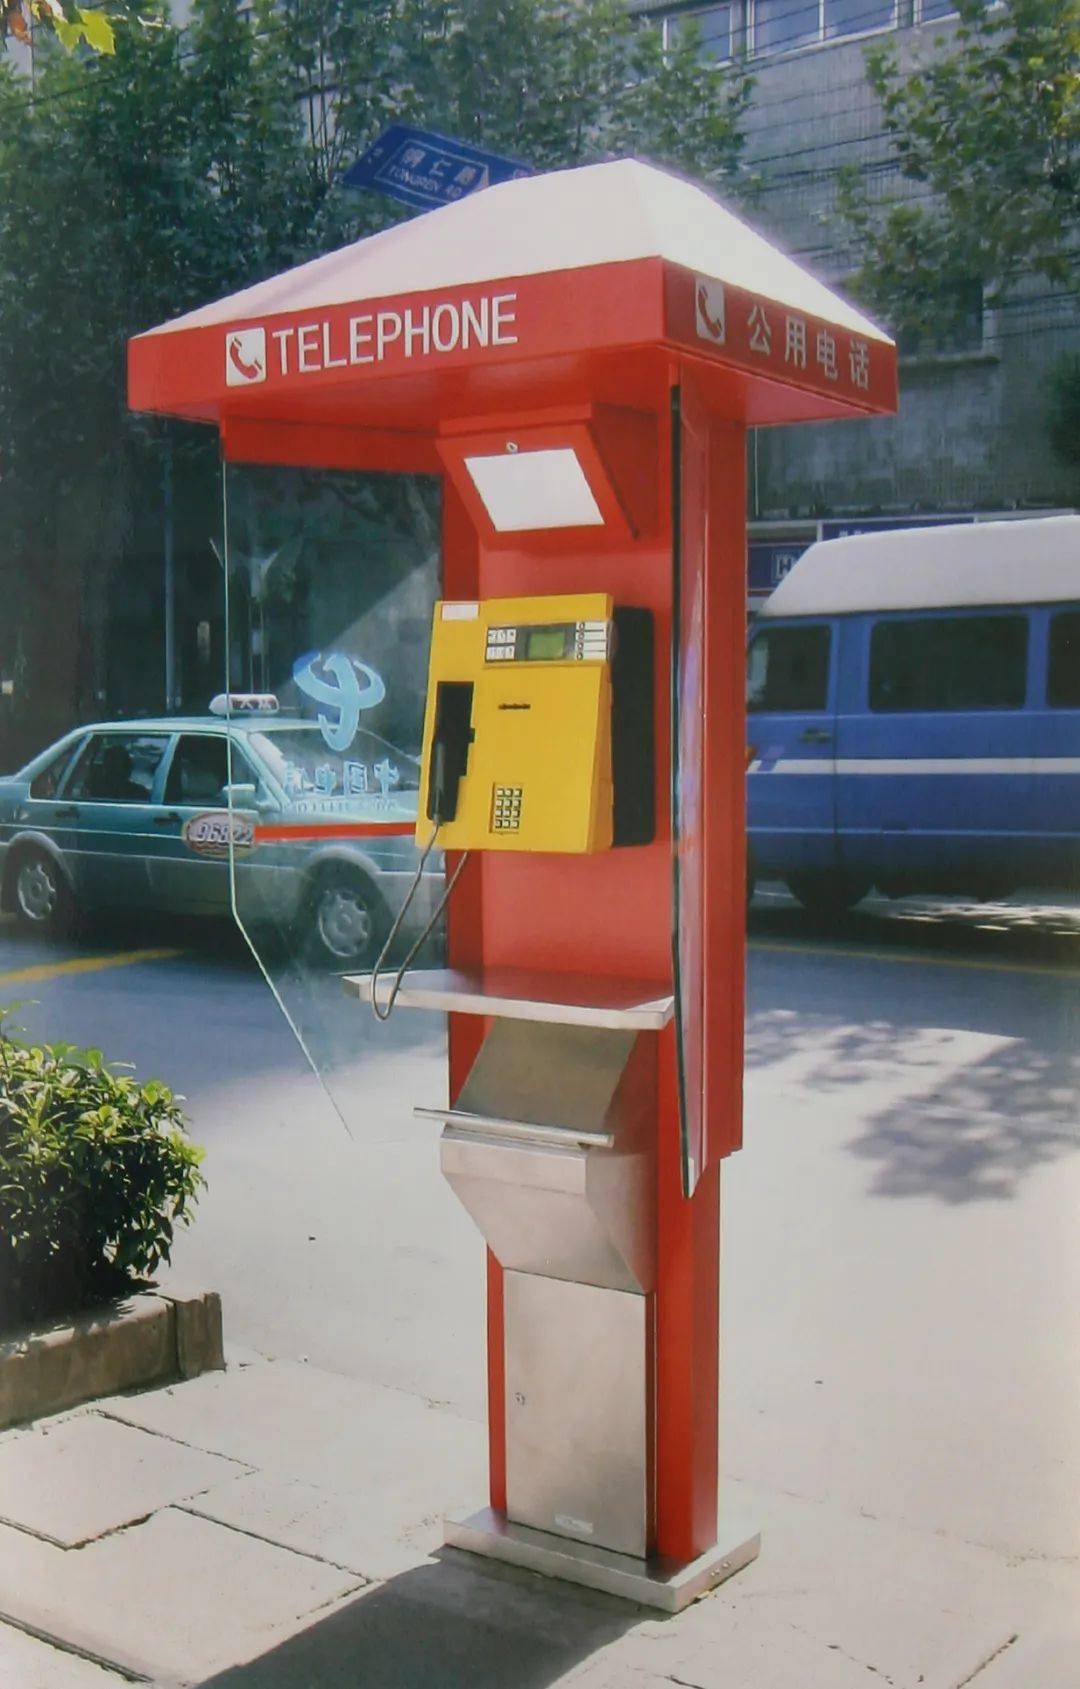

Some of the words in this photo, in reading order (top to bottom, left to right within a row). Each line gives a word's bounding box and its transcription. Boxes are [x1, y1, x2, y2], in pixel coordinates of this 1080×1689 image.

[272, 293, 518, 376] TELEPHONE
[747, 304, 870, 390] 公用电话
